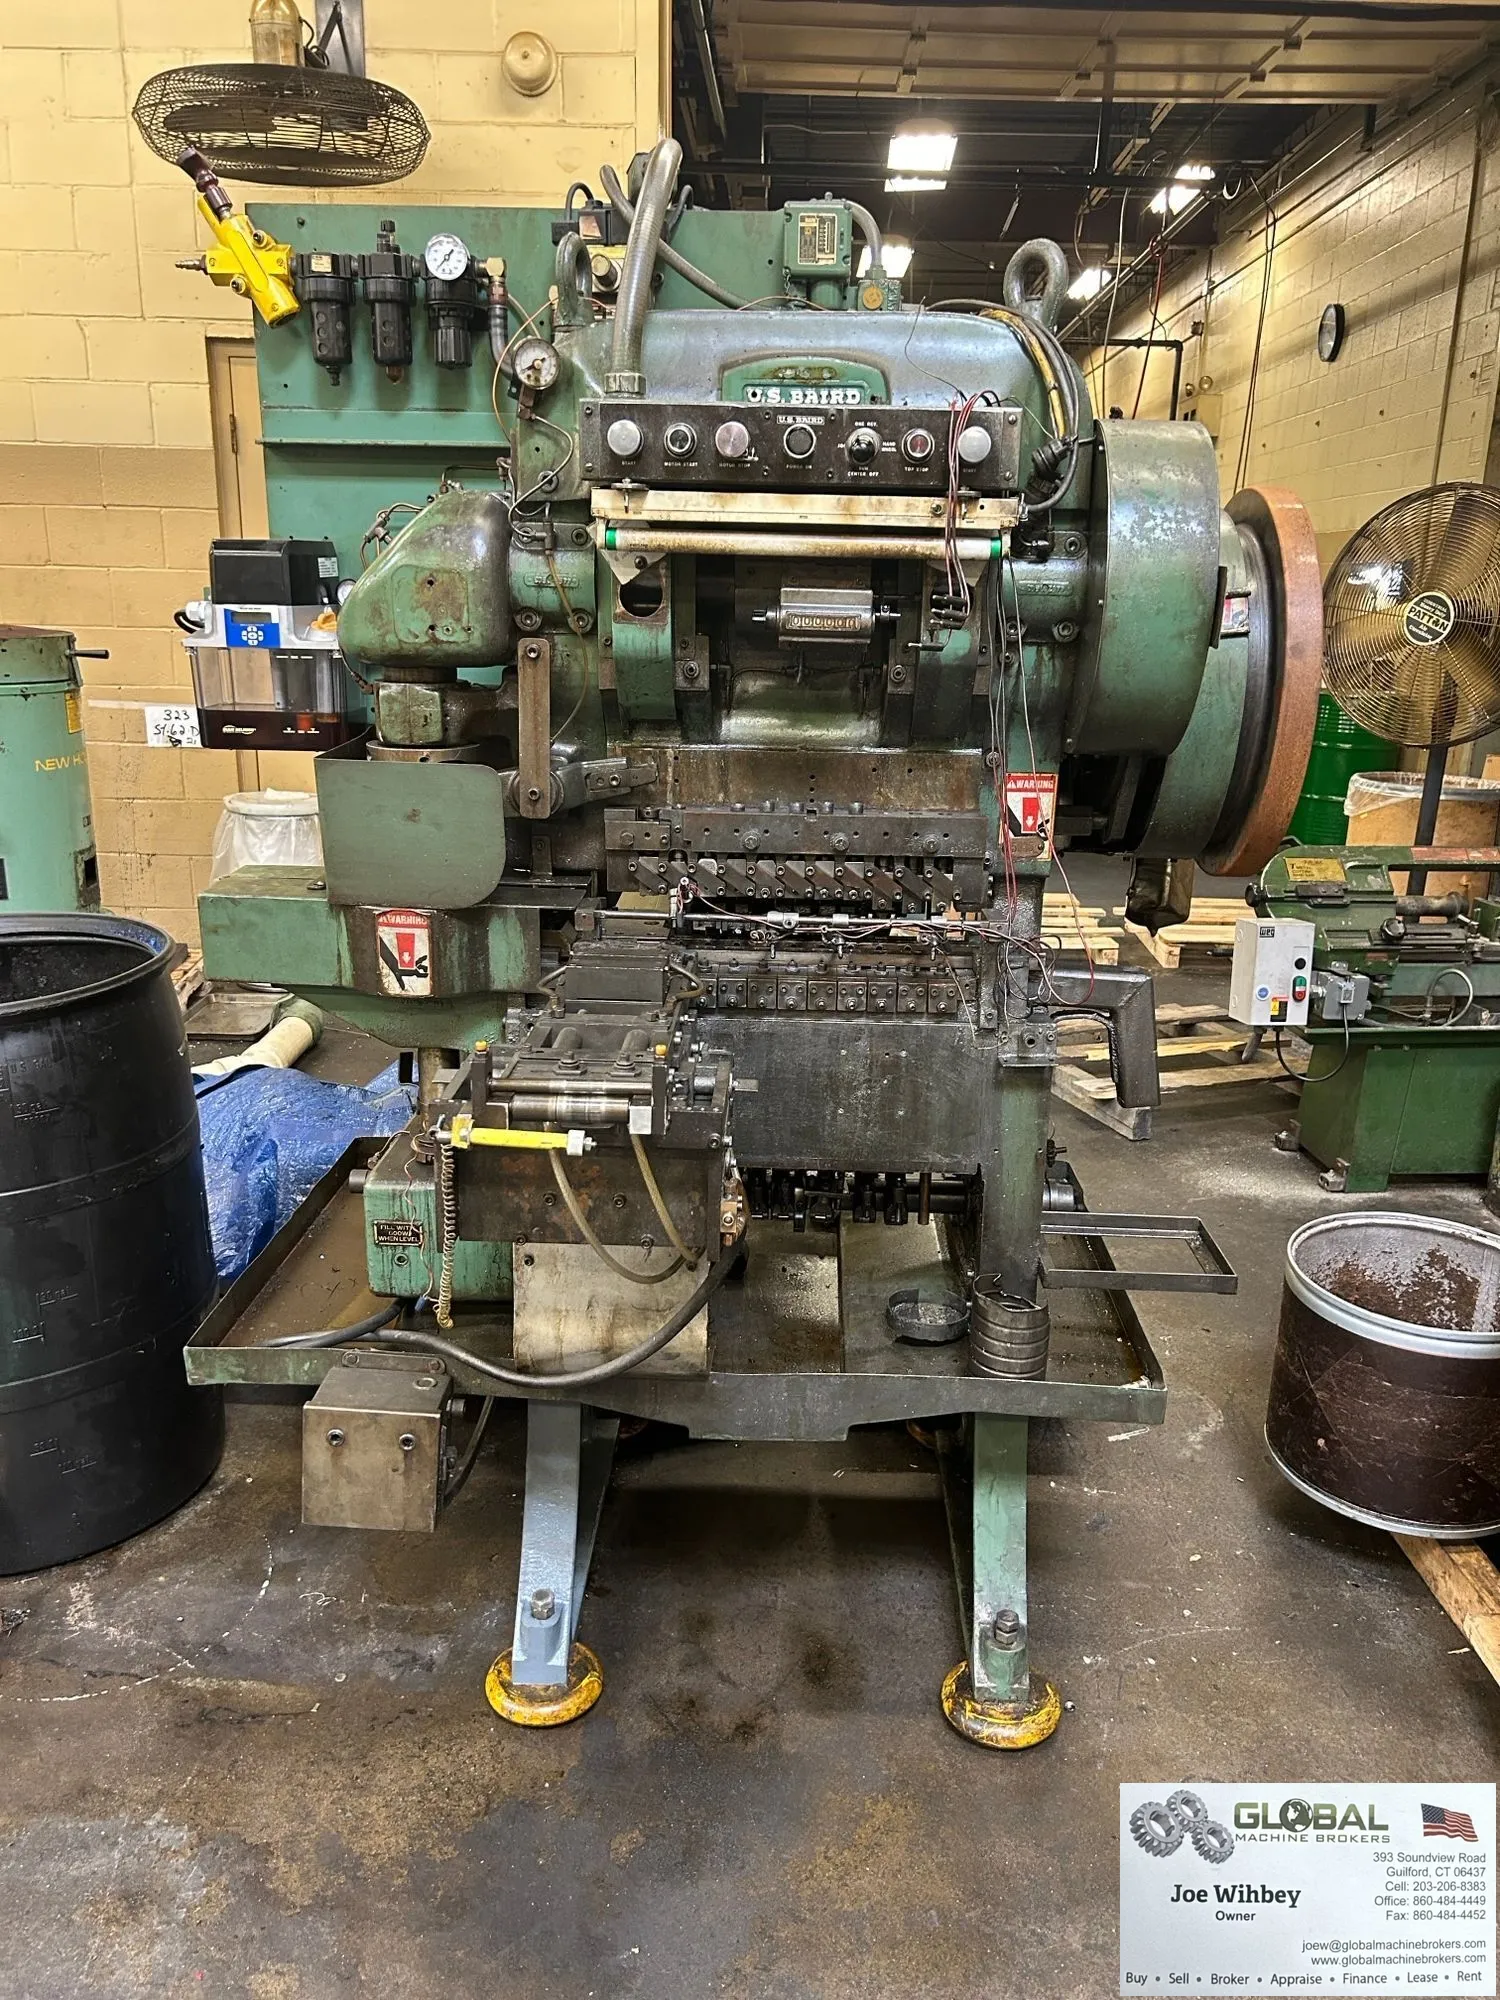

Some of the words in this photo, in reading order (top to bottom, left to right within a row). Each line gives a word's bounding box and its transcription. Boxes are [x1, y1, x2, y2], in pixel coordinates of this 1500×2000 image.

[746, 387, 786, 404] U.S.
[789, 388, 862, 405] BAIRD
[778, 416, 795, 425] U.S.
[796, 416, 824, 425] BAIRD
[1408, 606, 1449, 632] PATTON
[163, 709, 190, 721] 323
[35, 756, 70, 772] NEW
[387, 914, 428, 925] WARNING
